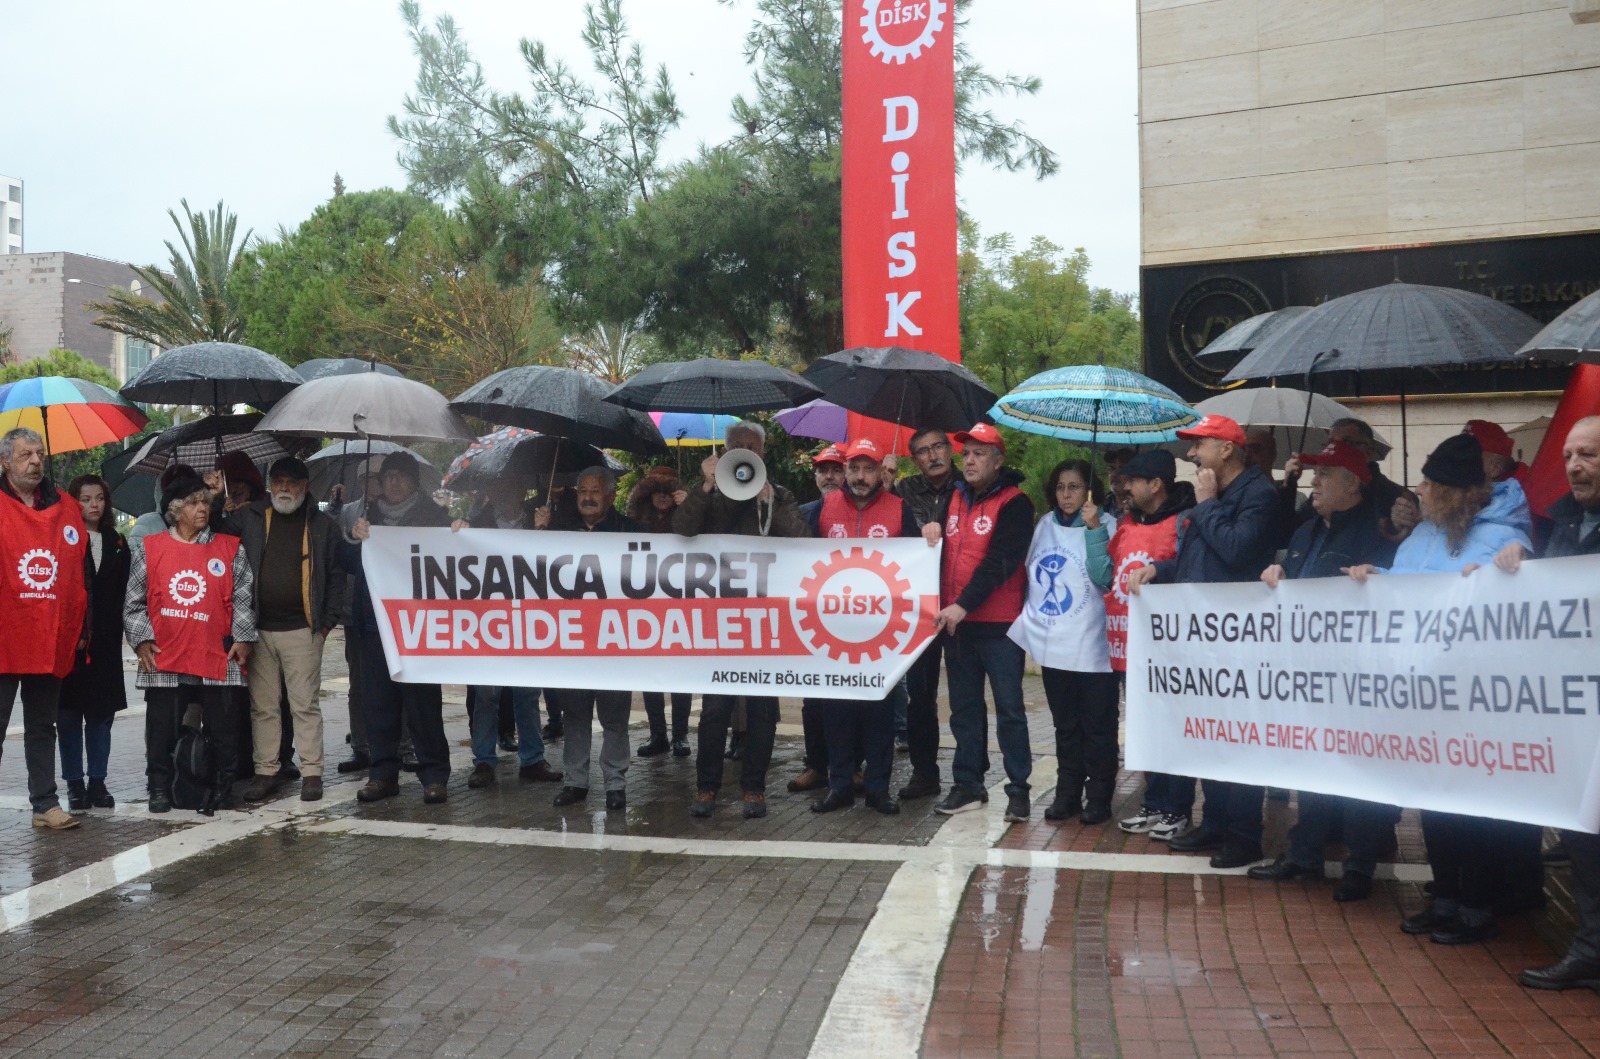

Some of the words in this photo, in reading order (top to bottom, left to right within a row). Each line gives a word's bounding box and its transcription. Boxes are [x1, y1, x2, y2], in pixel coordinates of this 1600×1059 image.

[879, 0, 926, 27] DİSK
[882, 95, 923, 338] DİSK
[28, 563, 52, 575] DİSK
[177, 581, 199, 592] DİSK
[411, 544, 607, 600] İNSANCA
[620, 542, 776, 599] ÜCRET
[398, 599, 585, 650] VERGİDE
[597, 608, 781, 650] ADALET!
[822, 586, 887, 615] DİSK
[1150, 614, 1180, 641] BU
[1187, 604, 1281, 642] ASGARİ
[1291, 604, 1405, 643] ÜCRETLE
[1414, 598, 1593, 651] YAŞANMAZ!
[712, 669, 771, 684] AKDENİZ
[775, 670, 820, 686] BÖLGE
[1148, 658, 1250, 699] İNSANCA
[1257, 662, 1337, 704] ÜCRET
[1343, 666, 1459, 711] VERGİDE
[1184, 717, 1261, 746] ANTALYA
[1266, 723, 1318, 752] EMEK
[1324, 730, 1441, 765] DEMOKRASİ
[1446, 733, 1556, 776] GÜÇLERİ
